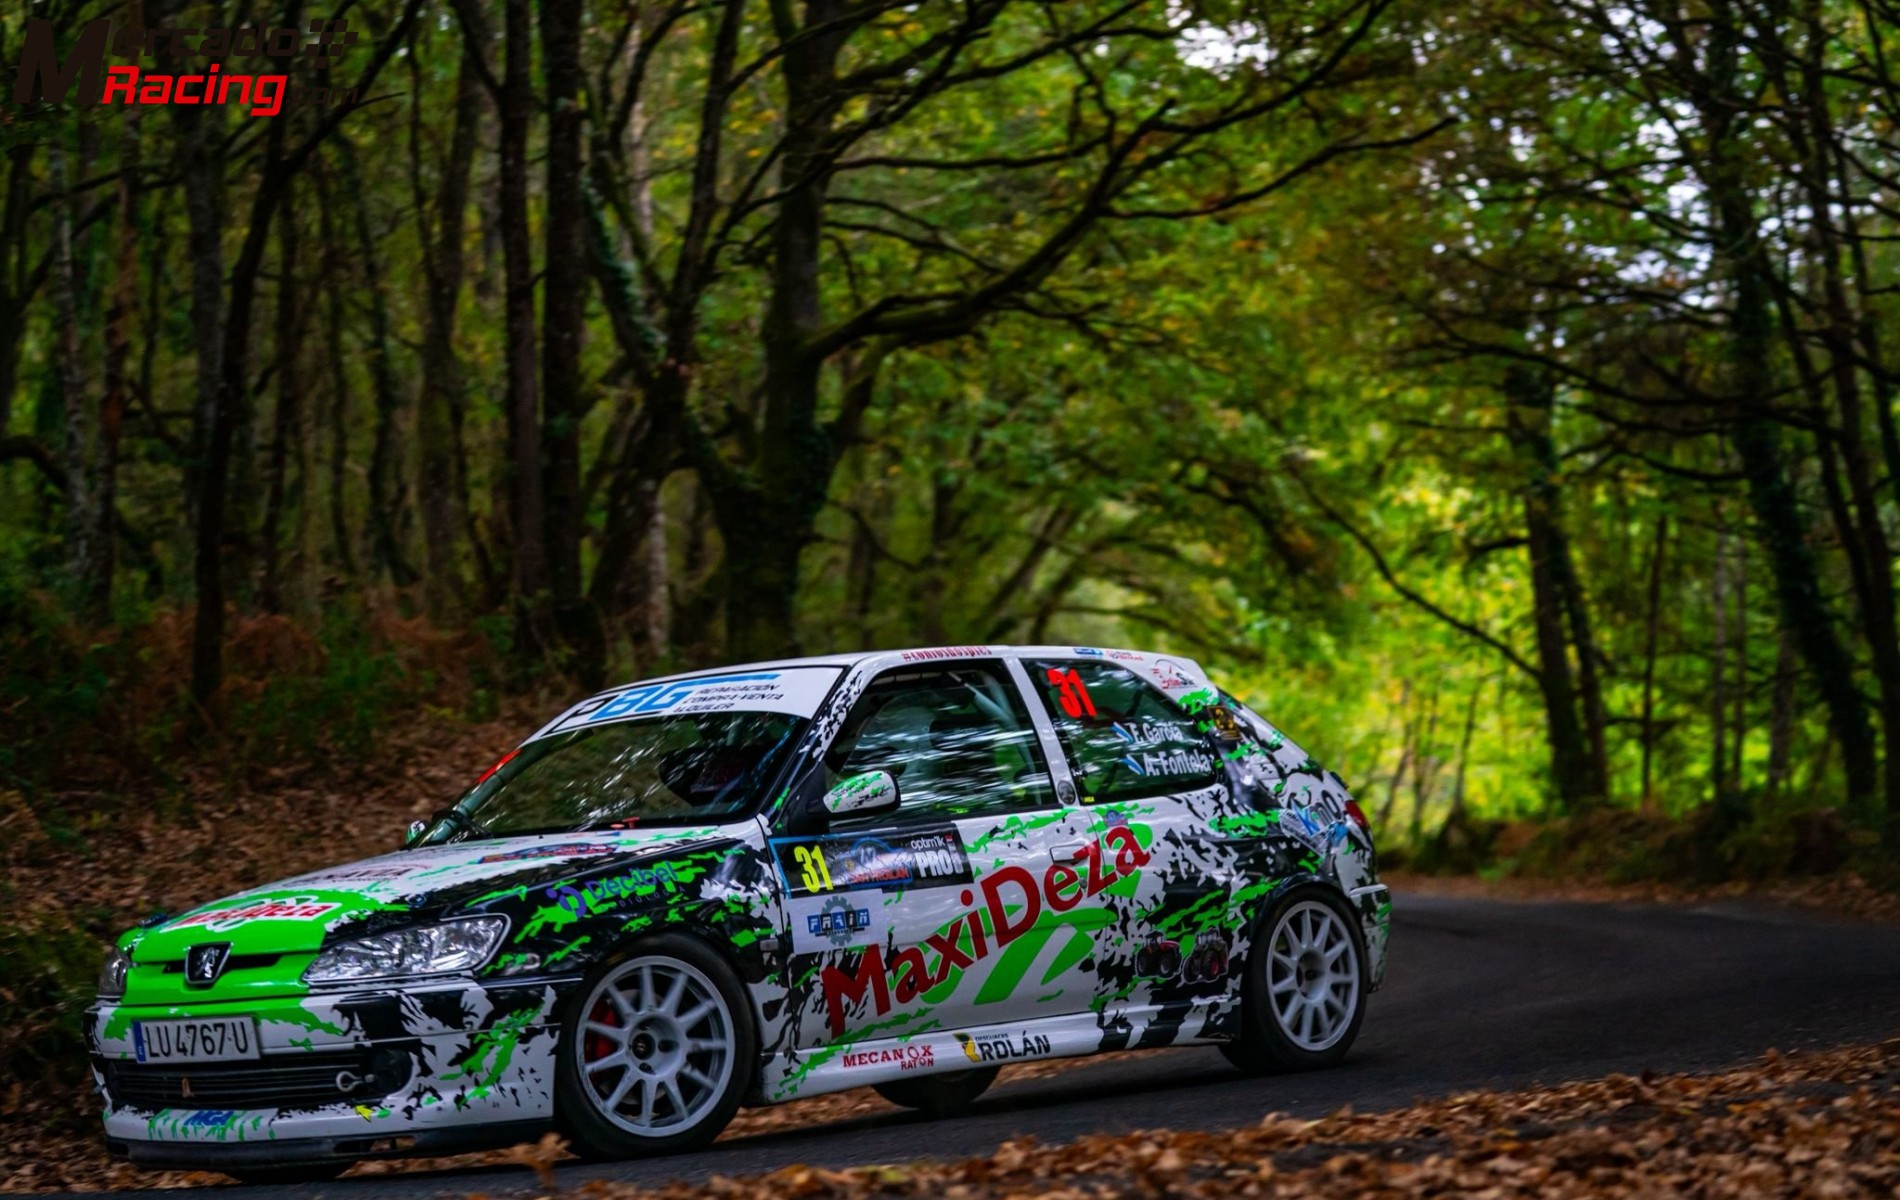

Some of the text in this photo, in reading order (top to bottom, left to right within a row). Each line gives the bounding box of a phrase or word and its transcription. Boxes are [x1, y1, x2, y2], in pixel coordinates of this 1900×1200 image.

[1046, 668, 1097, 718] 31
[584, 860, 678, 900] Decibel
[794, 844, 834, 893] 31
[977, 1029, 1051, 1061] ROLÁN
